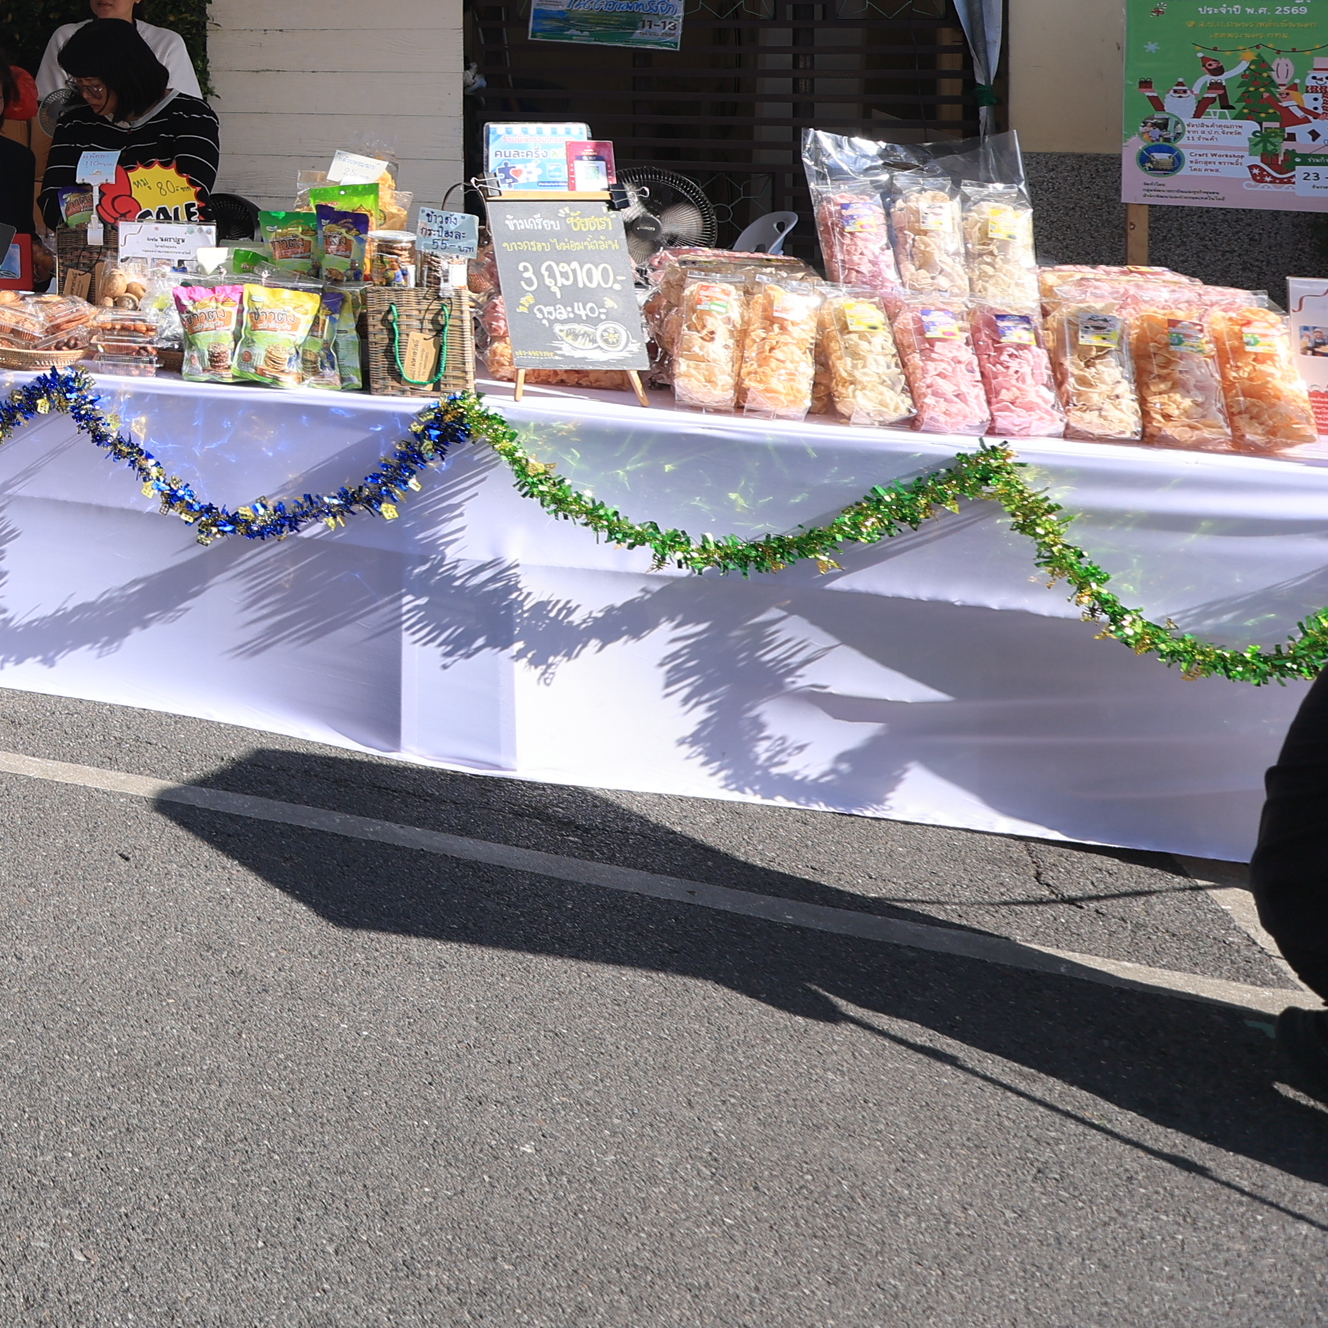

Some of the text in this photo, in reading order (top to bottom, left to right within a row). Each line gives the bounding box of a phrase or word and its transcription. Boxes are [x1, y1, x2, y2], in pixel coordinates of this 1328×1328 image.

[1198, 4, 1308, 15] ประจำปี พ.ศ. 2569
[494, 144, 549, 159] คนละครึ่ง
[1303, 172, 1320, 181] 23
[505, 213, 561, 231] ข้าวเกรียบ
[519, 262, 538, 292] 3
[253, 307, 296, 322] ข้าวตัง
